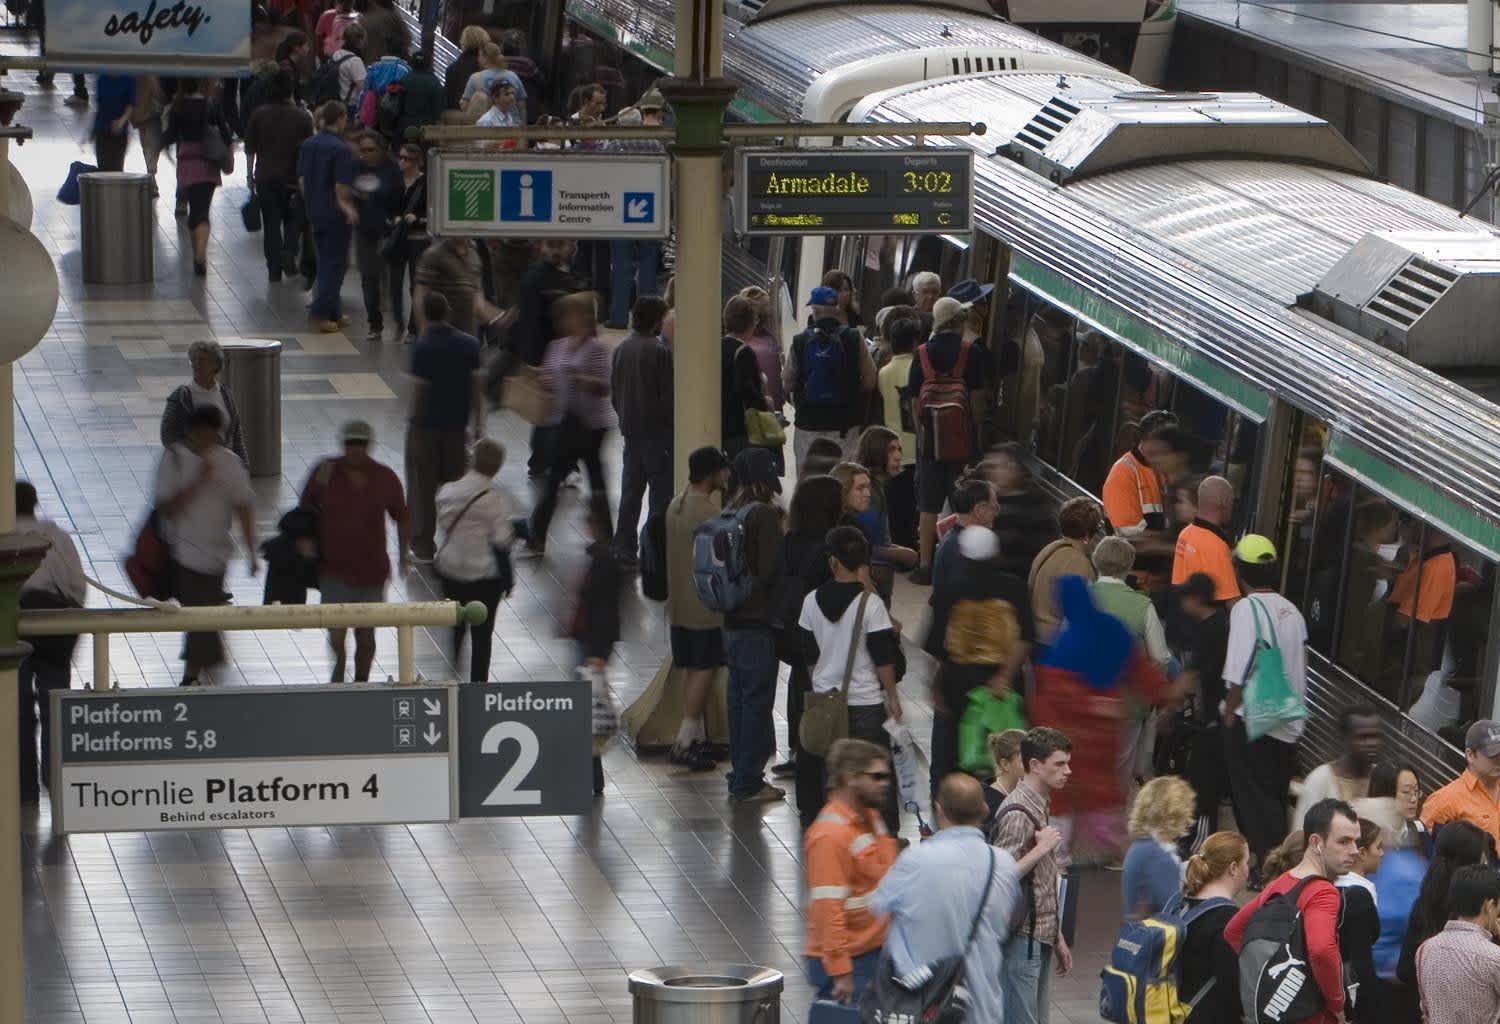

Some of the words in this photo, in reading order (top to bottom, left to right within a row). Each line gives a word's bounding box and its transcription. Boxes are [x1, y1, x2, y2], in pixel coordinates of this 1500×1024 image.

[104, 0, 211, 45] safety.
[766, 172, 870, 193] Armadale
[903, 171, 953, 192] 3:02
[559, 190, 611, 202] Transperth
[559, 203, 615, 213] Information
[559, 214, 593, 224] Centre
[484, 691, 574, 712] Platform
[71, 703, 163, 725] Platform
[174, 703, 188, 722] 2
[71, 731, 173, 753] Platforms
[184, 729, 218, 752] 5,8
[480, 720, 542, 806] 2
[71, 780, 194, 808] Thornlie
[206, 776, 350, 804] Platform
[361, 773, 379, 798] 4
[160, 811, 206, 823] Behind
[209, 809, 276, 822] escalators
[1263, 967, 1307, 1022] PUMA
